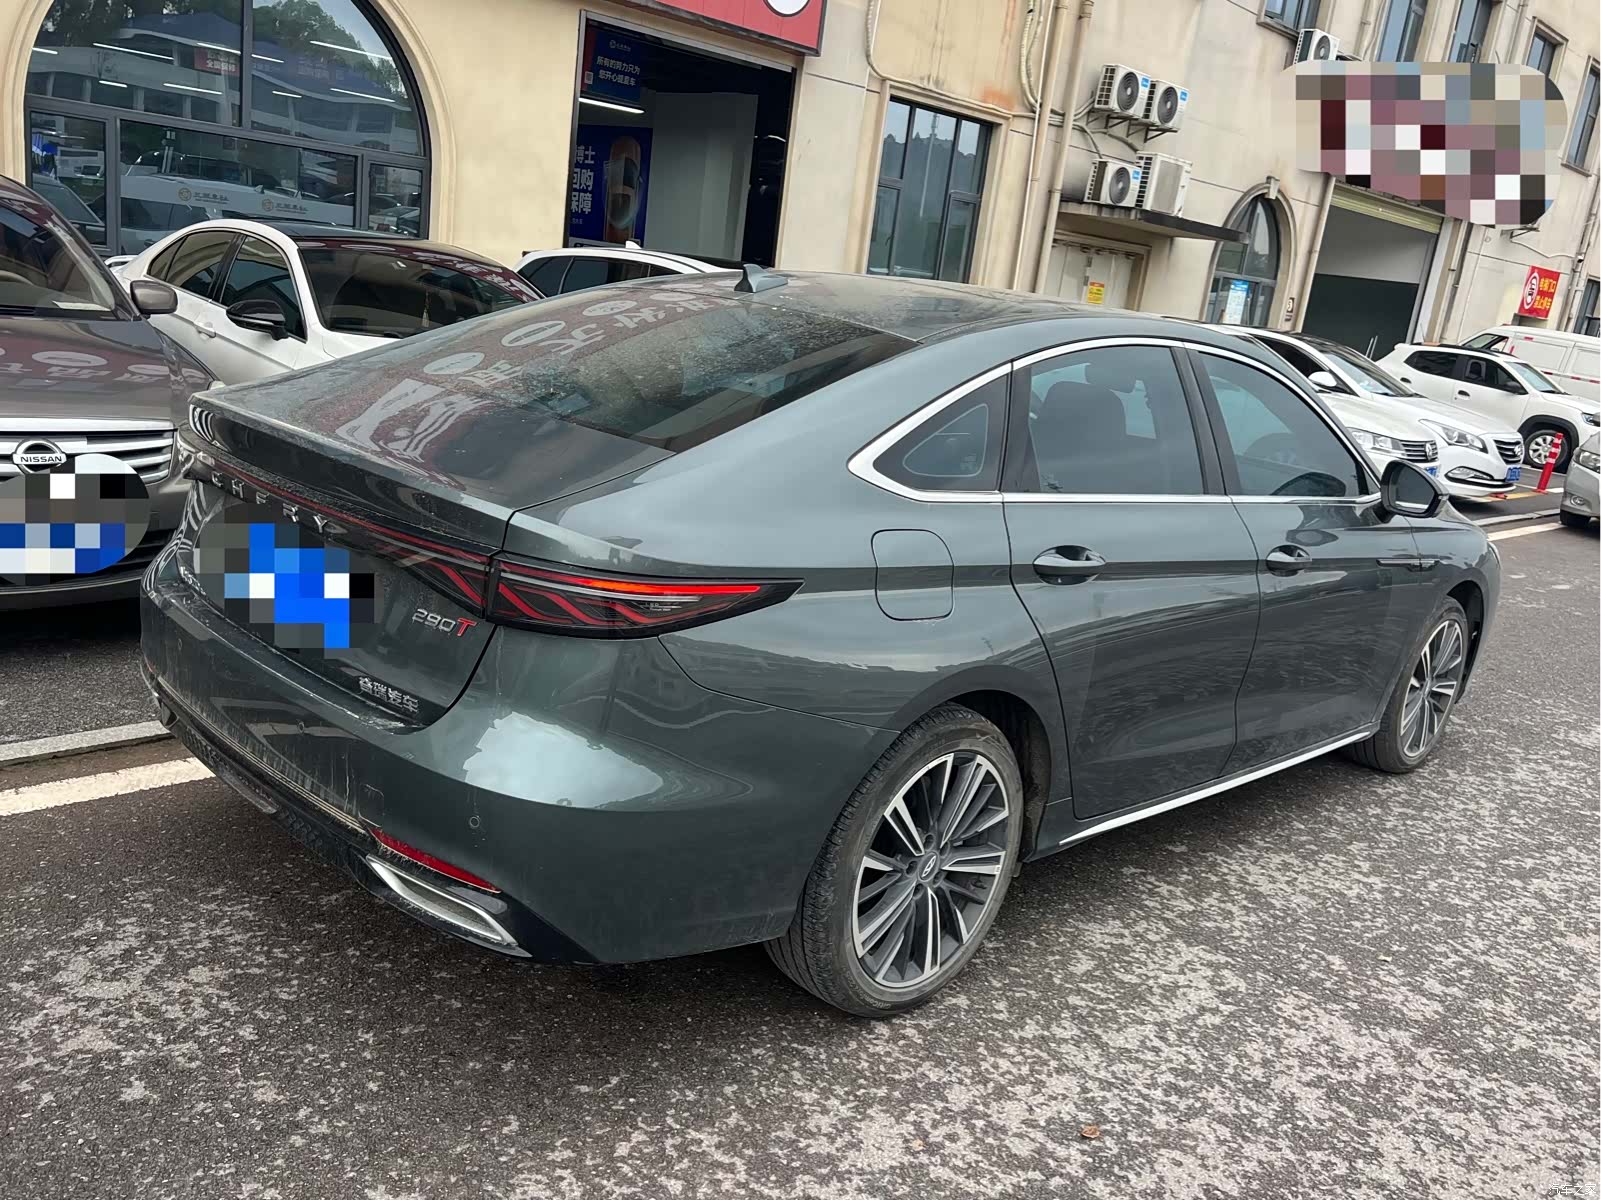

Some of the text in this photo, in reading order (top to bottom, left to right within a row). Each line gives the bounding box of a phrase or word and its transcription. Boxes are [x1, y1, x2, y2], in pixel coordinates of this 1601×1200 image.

[596, 56, 641, 76] 所有的努力只为
[20, 455, 62, 463] NISSAN
[412, 608, 477, 637] 290T
[358, 676, 419, 714] 奇瑞汽车
